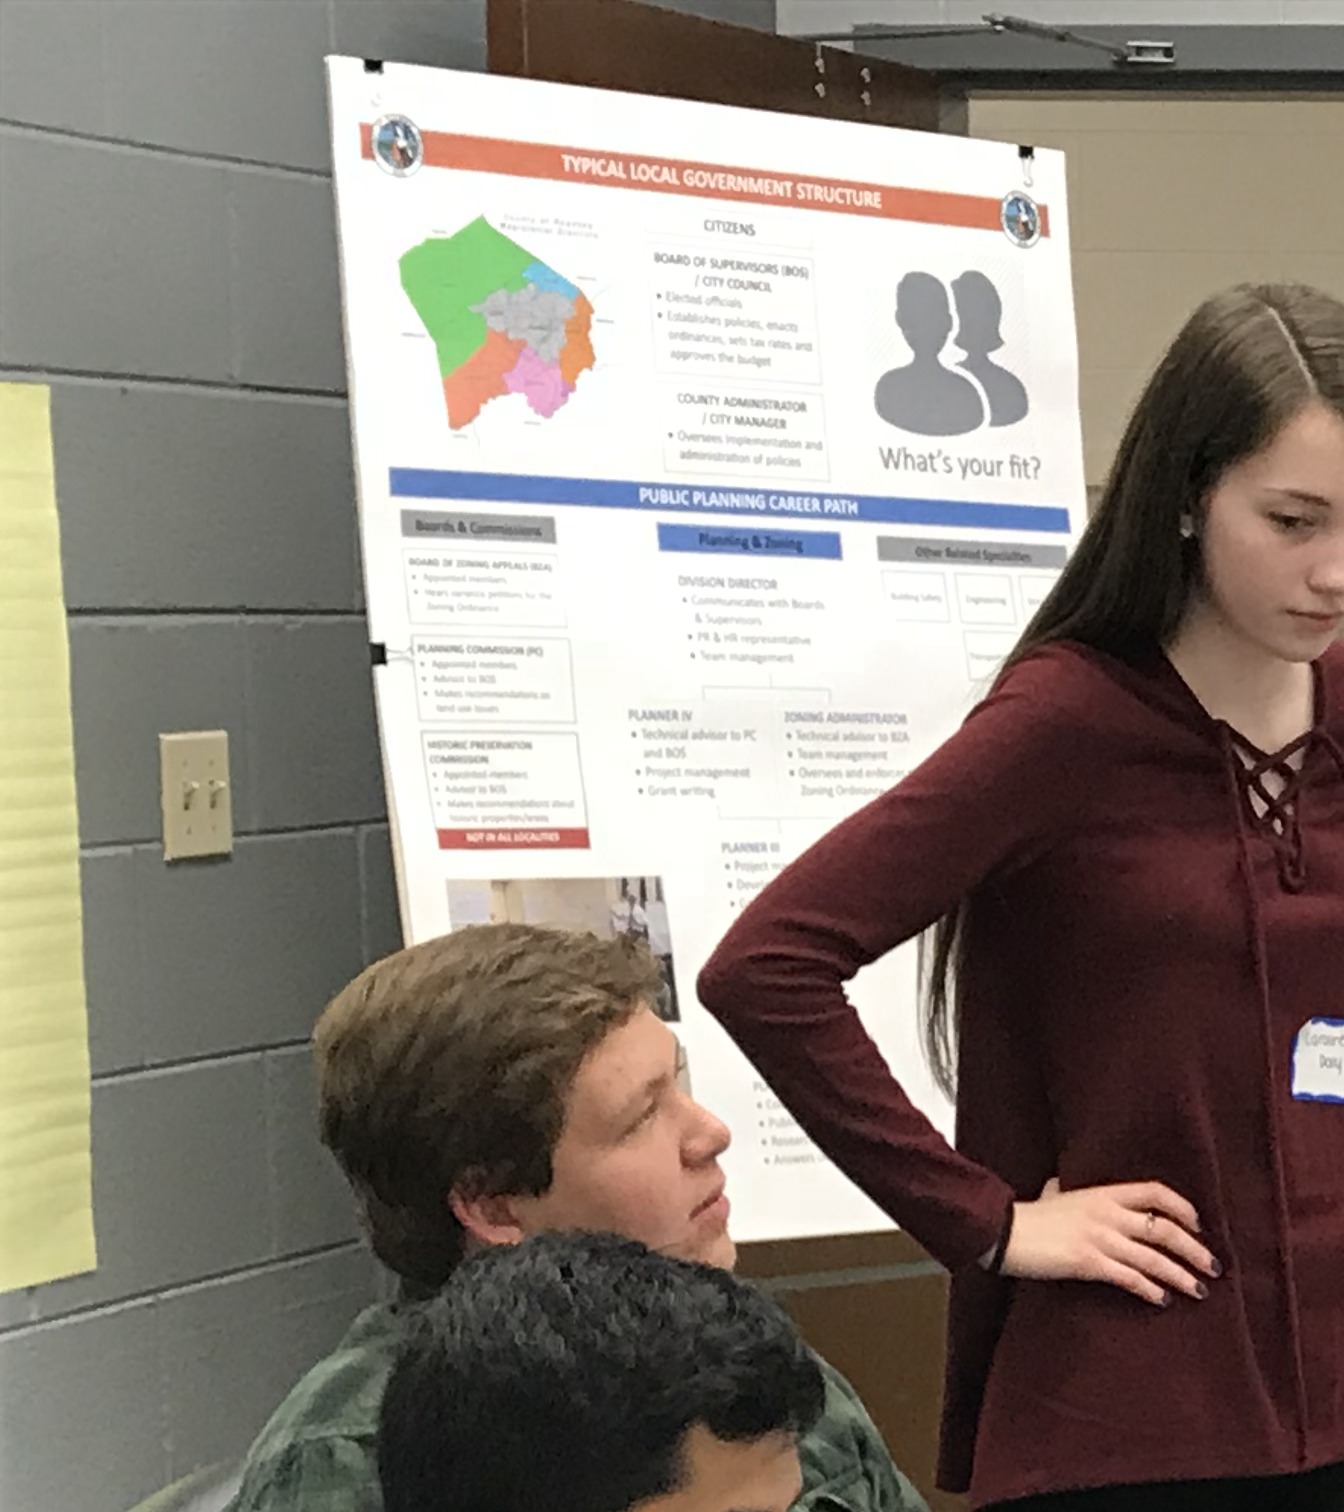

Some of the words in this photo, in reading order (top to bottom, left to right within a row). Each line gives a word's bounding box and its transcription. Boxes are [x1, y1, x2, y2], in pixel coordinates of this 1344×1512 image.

[561, 154, 626, 179] TYPICAL
[630, 162, 680, 185] LOCAL
[683, 168, 791, 197] GOVERNMENT
[796, 182, 882, 208] STRUCTURE
[703, 219, 756, 237] CITIZENS
[653, 251, 691, 266] BOARD
[693, 255, 707, 268] OF
[709, 258, 779, 276] SUPERVISORS
[702, 275, 725, 288] CITY
[727, 277, 772, 293] COUNCIL
[665, 290, 703, 305] Elected
[705, 295, 743, 309] officials
[667, 310, 722, 326] Establishes
[729, 336, 747, 347] sets
[750, 337, 765, 348] tax
[768, 339, 792, 352] rates
[795, 341, 813, 352] and
[670, 350, 716, 362] approves
[718, 351, 734, 364] the
[737, 353, 772, 368] budget
[677, 392, 720, 406] COUNTY
[724, 395, 808, 413] ADMINISTRATOR
[710, 413, 731, 426] CITY
[734, 414, 787, 430] MANAGER
[677, 430, 723, 443] Oversees
[726, 433, 802, 450] implementation
[805, 439, 823, 451] and
[679, 449, 751, 464] administration
[766, 454, 802, 468] policies
[957, 456, 1004, 480] your
[1009, 454, 1041, 480] fit?
[639, 487, 689, 505] PUBLIC
[693, 491, 766, 510] PLANNING
[769, 496, 821, 512] CAREER
[824, 499, 858, 515] PATH
[415, 518, 456, 534] Boards
[457, 519, 467, 534] &
[469, 521, 543, 537] Commissions
[699, 530, 751, 551] Planning
[752, 533, 762, 549] &
[764, 534, 804, 553] Zoning
[678, 575, 725, 588] DIVISION
[728, 577, 778, 590] DIRECTOR
[691, 595, 765, 609] Communicates
[768, 598, 788, 609] with
[792, 598, 825, 611] Boards
[705, 614, 762, 627] Supervisors
[697, 632, 710, 642] PR
[741, 635, 812, 647] representative
[417, 644, 464, 655] PLANNING
[466, 644, 525, 656] COMMISSION
[700, 651, 726, 662] Team
[730, 652, 794, 664] management
[628, 709, 679, 722] PLANNER
[681, 710, 693, 722] IV
[784, 711, 824, 723] ZONING
[826, 712, 908, 725] ADMINISTRATOR
[641, 729, 689, 741] Technical
[691, 730, 728, 741] advisor
[730, 730, 741, 741] to
[743, 730, 757, 741] PC
[796, 729, 839, 742] Technical
[842, 731, 875, 742] advisor
[891, 731, 910, 742] BZA
[427, 740, 468, 751] HISTORIC
[470, 740, 533, 751] PRESERVATION
[643, 748, 663, 759] and
[665, 747, 686, 759] BOS
[429, 755, 489, 765] COMMISSION
[797, 748, 823, 759] Team
[825, 750, 888, 763] management
[645, 766, 682, 779] Project
[684, 767, 751, 780] management
[798, 767, 843, 778] Oversees
[845, 768, 863, 778] and
[648, 785, 677, 796] Grant
[680, 786, 716, 799] writing
[800, 785, 834, 798] Zoning
[466, 832, 484, 841] NOT
[497, 832, 512, 841] ALL
[514, 832, 560, 842] LOCALITIES
[721, 842, 768, 854] PLANNER
[734, 860, 768, 874] Project
[774, 1154, 815, 1165] Answers
